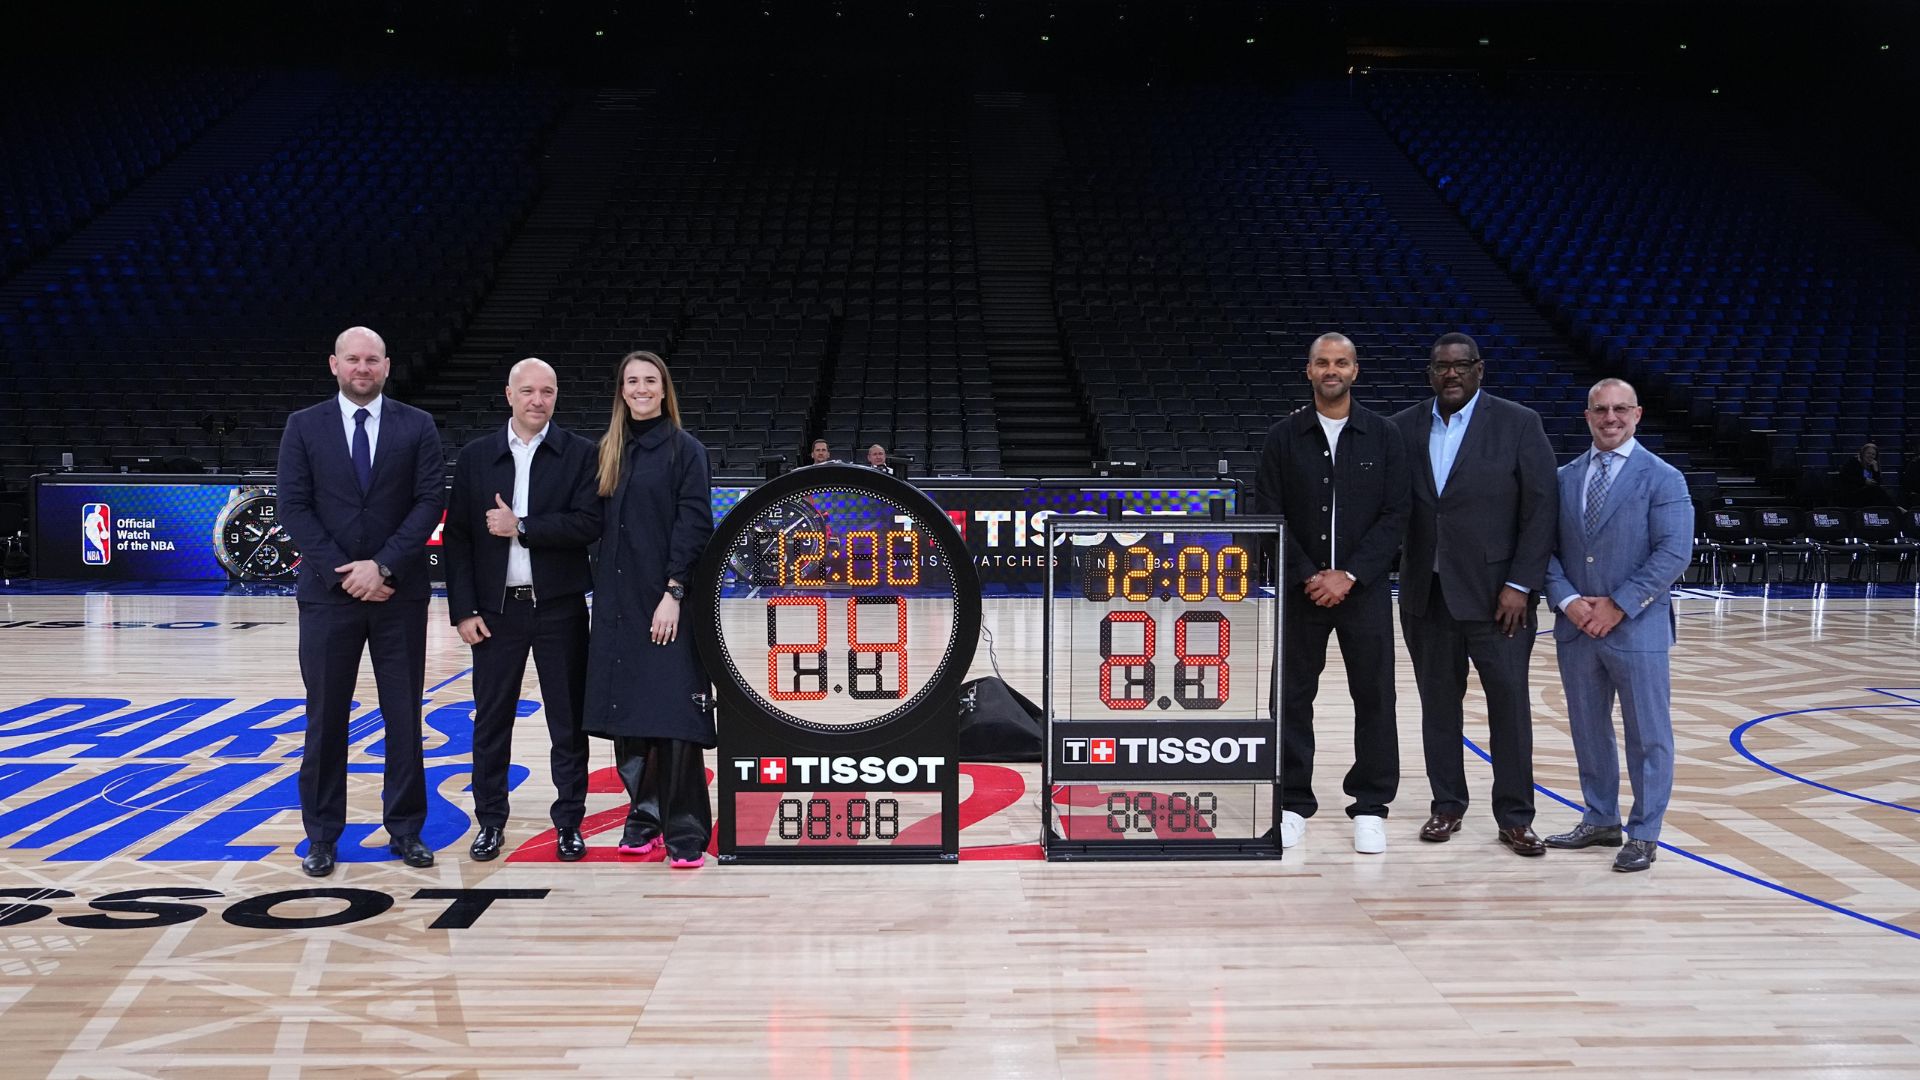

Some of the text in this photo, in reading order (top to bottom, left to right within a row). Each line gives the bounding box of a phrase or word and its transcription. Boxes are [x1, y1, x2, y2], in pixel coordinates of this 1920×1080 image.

[117, 519, 155, 528] Official
[117, 530, 150, 539] Watch
[117, 541, 175, 550] of the NBA
[87, 551, 100, 561] NBA
[777, 530, 919, 587] 12:00
[973, 555, 1058, 567] ATCHES
[1107, 547, 1248, 602] 12:00
[1066, 737, 1266, 764] T TISSOT
[734, 756, 945, 784] T TISSOT
